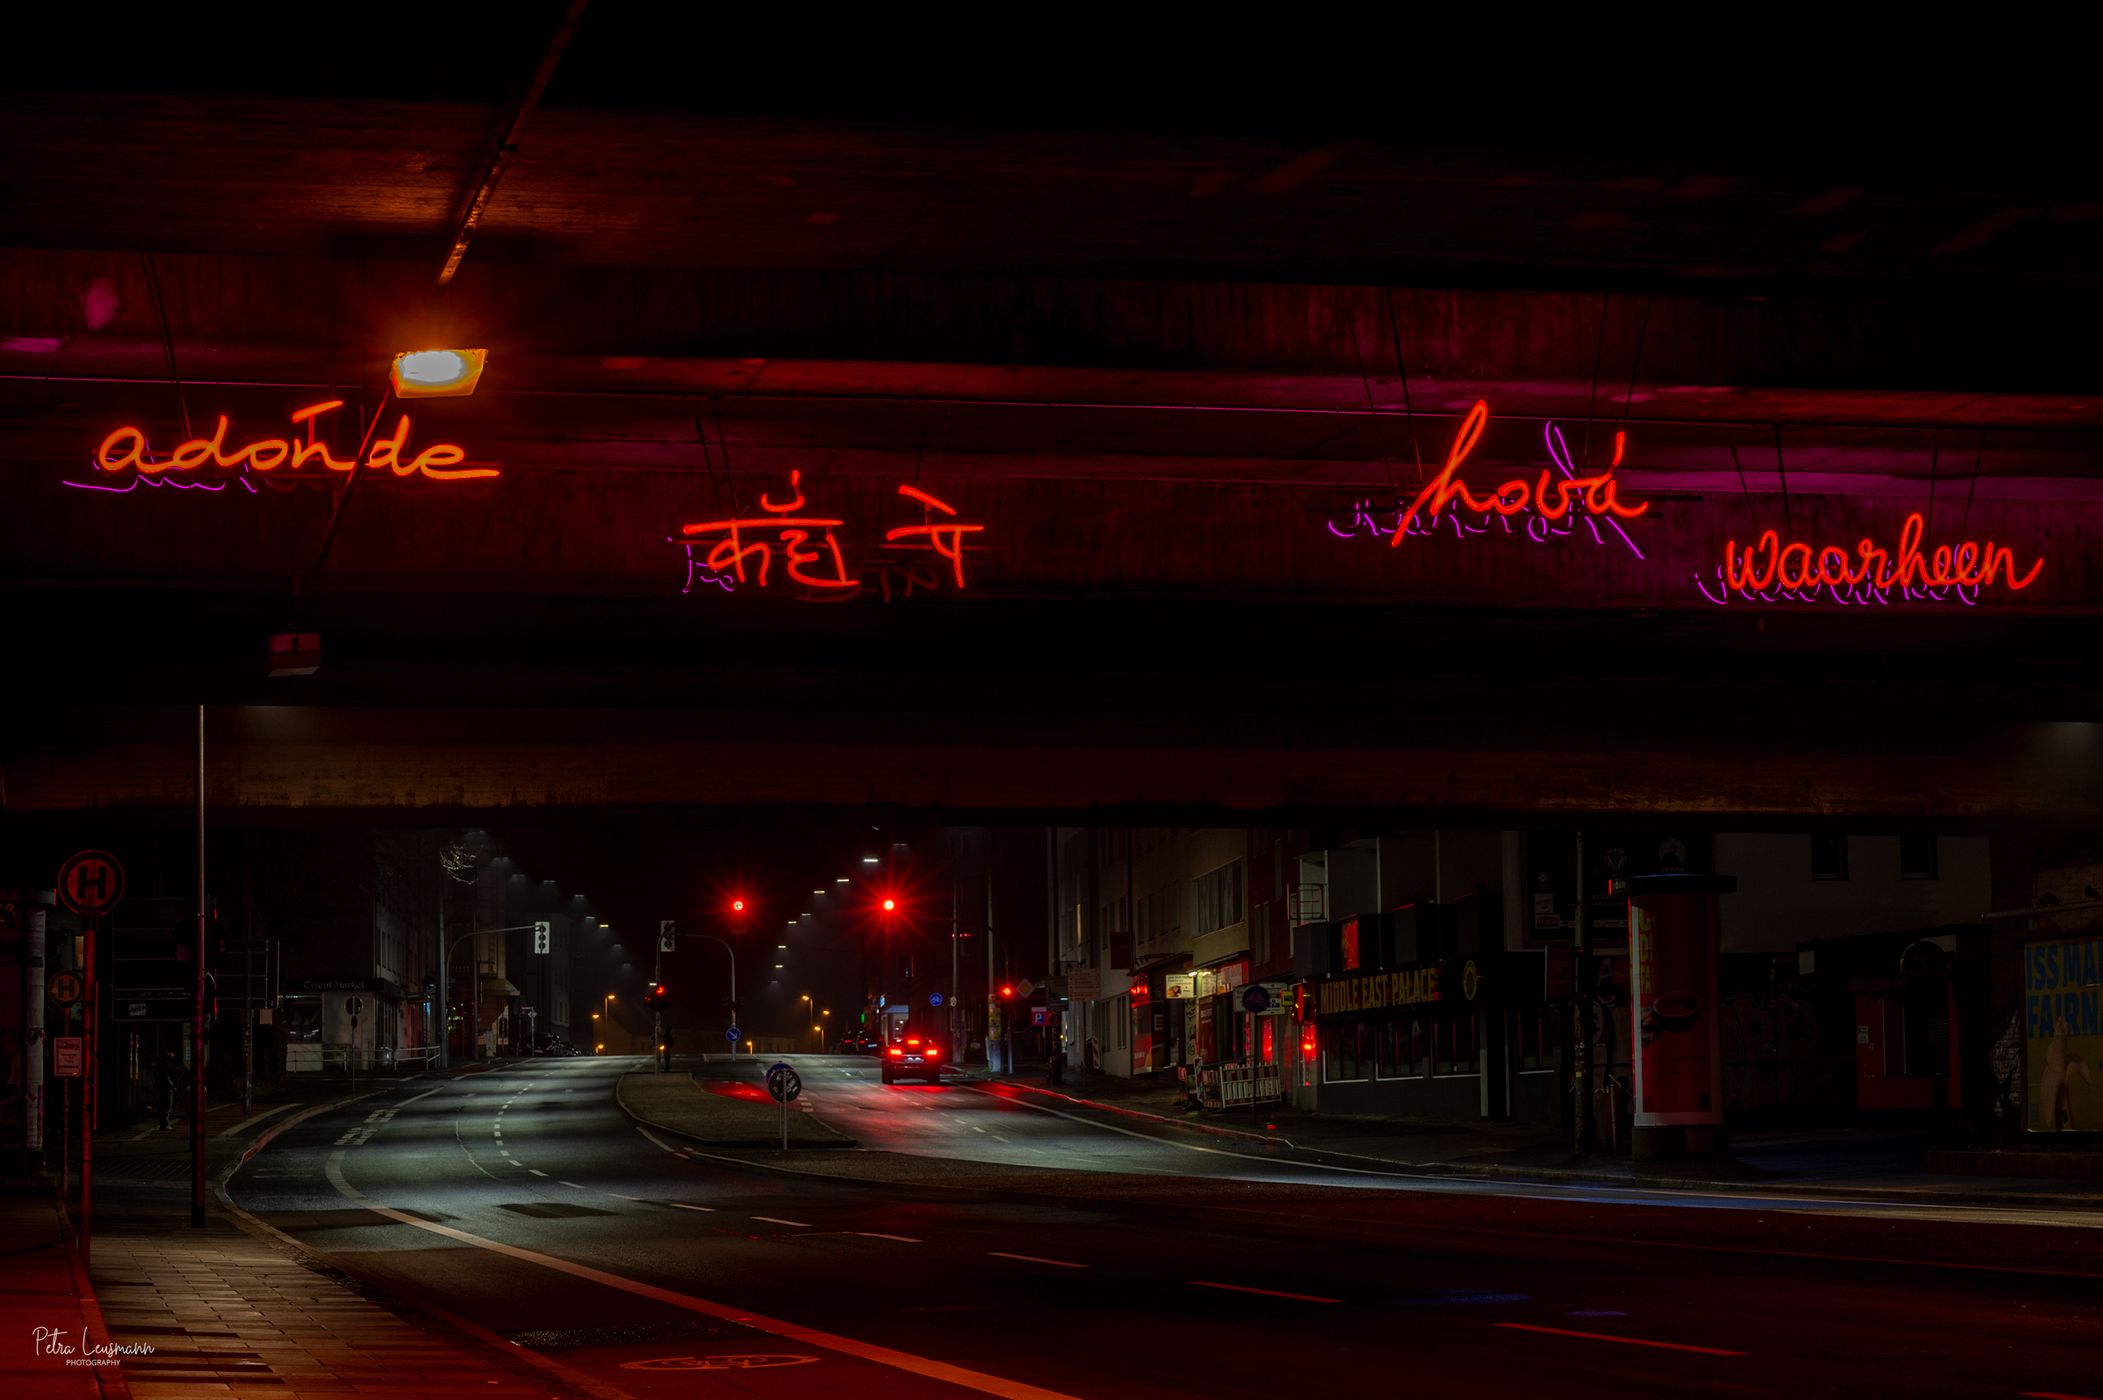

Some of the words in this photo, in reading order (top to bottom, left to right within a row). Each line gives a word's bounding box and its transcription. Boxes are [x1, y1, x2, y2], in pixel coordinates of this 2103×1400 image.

[1725, 512, 2044, 591] waarheen
[75, 866, 111, 901] H
[1320, 978, 1360, 1015] MIDDLE
[1361, 973, 1389, 1009] EAST
[1391, 966, 1435, 1007] PALACE
[2027, 944, 2059, 992] ISS
[2027, 990, 2103, 1040] FAIRN
